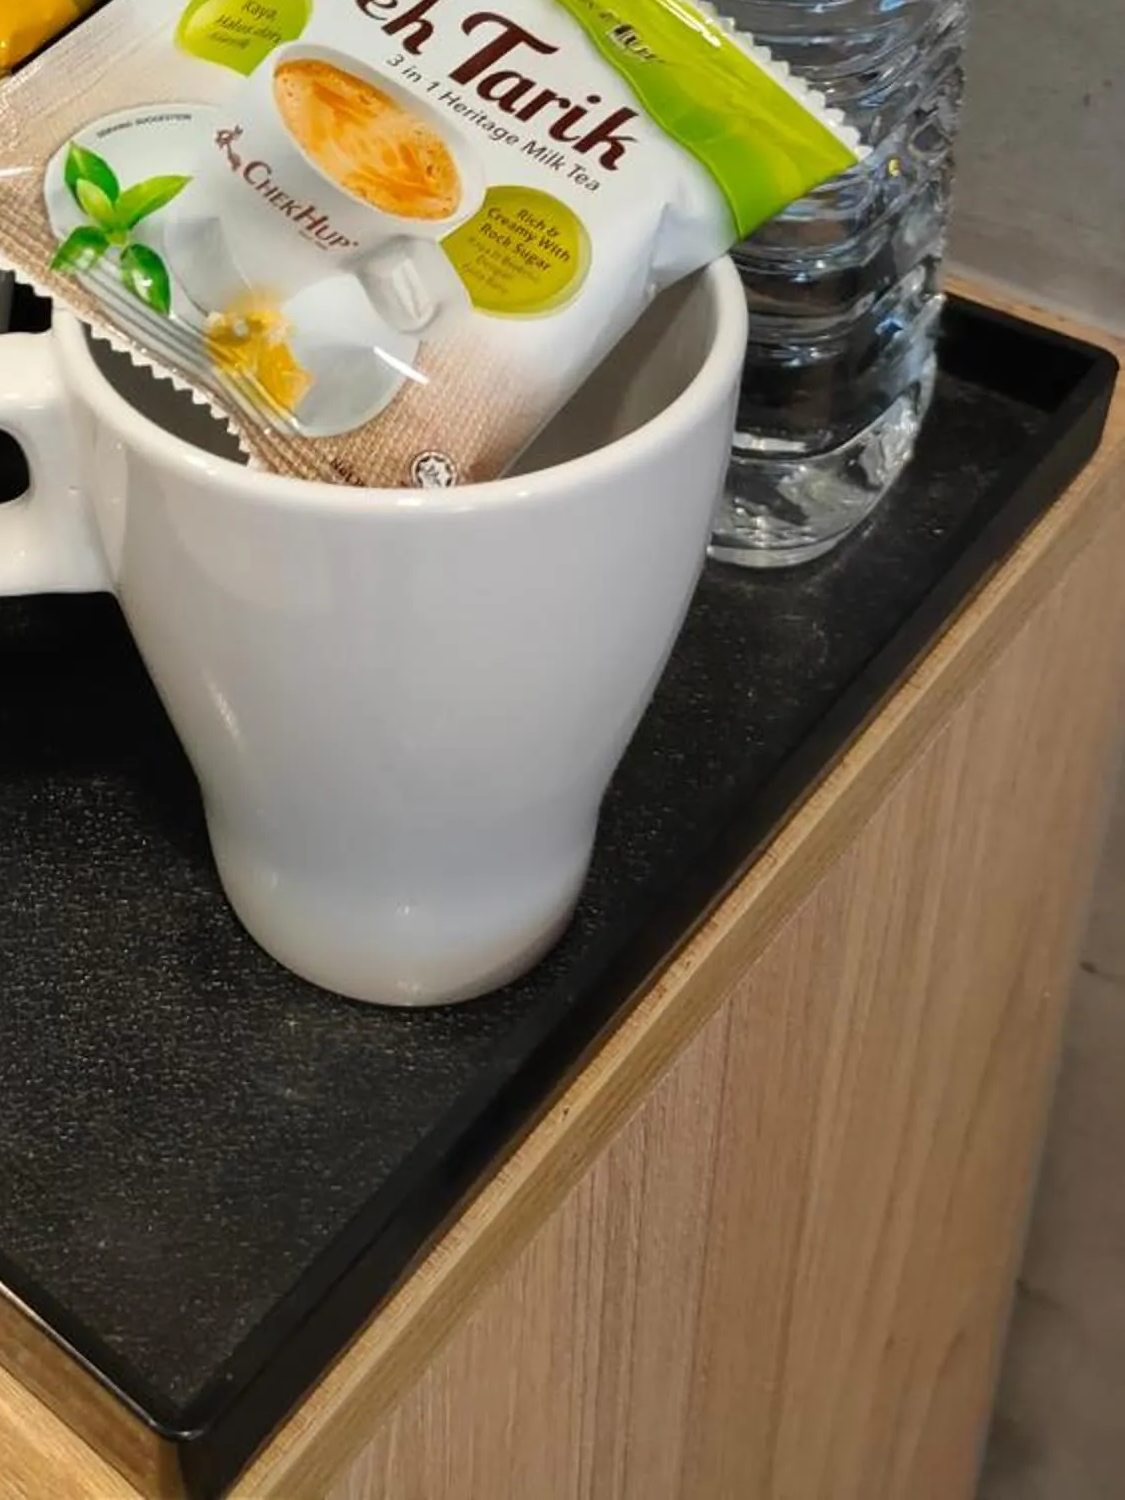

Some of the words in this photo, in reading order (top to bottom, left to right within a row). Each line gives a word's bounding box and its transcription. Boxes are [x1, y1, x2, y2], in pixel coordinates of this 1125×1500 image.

[447, 11, 640, 172] Tarik
[385, 53, 405, 68] 3
[401, 64, 423, 84] in
[426, 80, 441, 93] 1
[437, 88, 520, 147] Heritage
[520, 138, 567, 172] Milk
[566, 162, 601, 192] Tea
[479, 222, 513, 248] Rock
[513, 242, 552, 272] Sugar
[486, 206, 537, 243] Creamy
[538, 236, 572, 262] With
[516, 208, 547, 231] Rich
